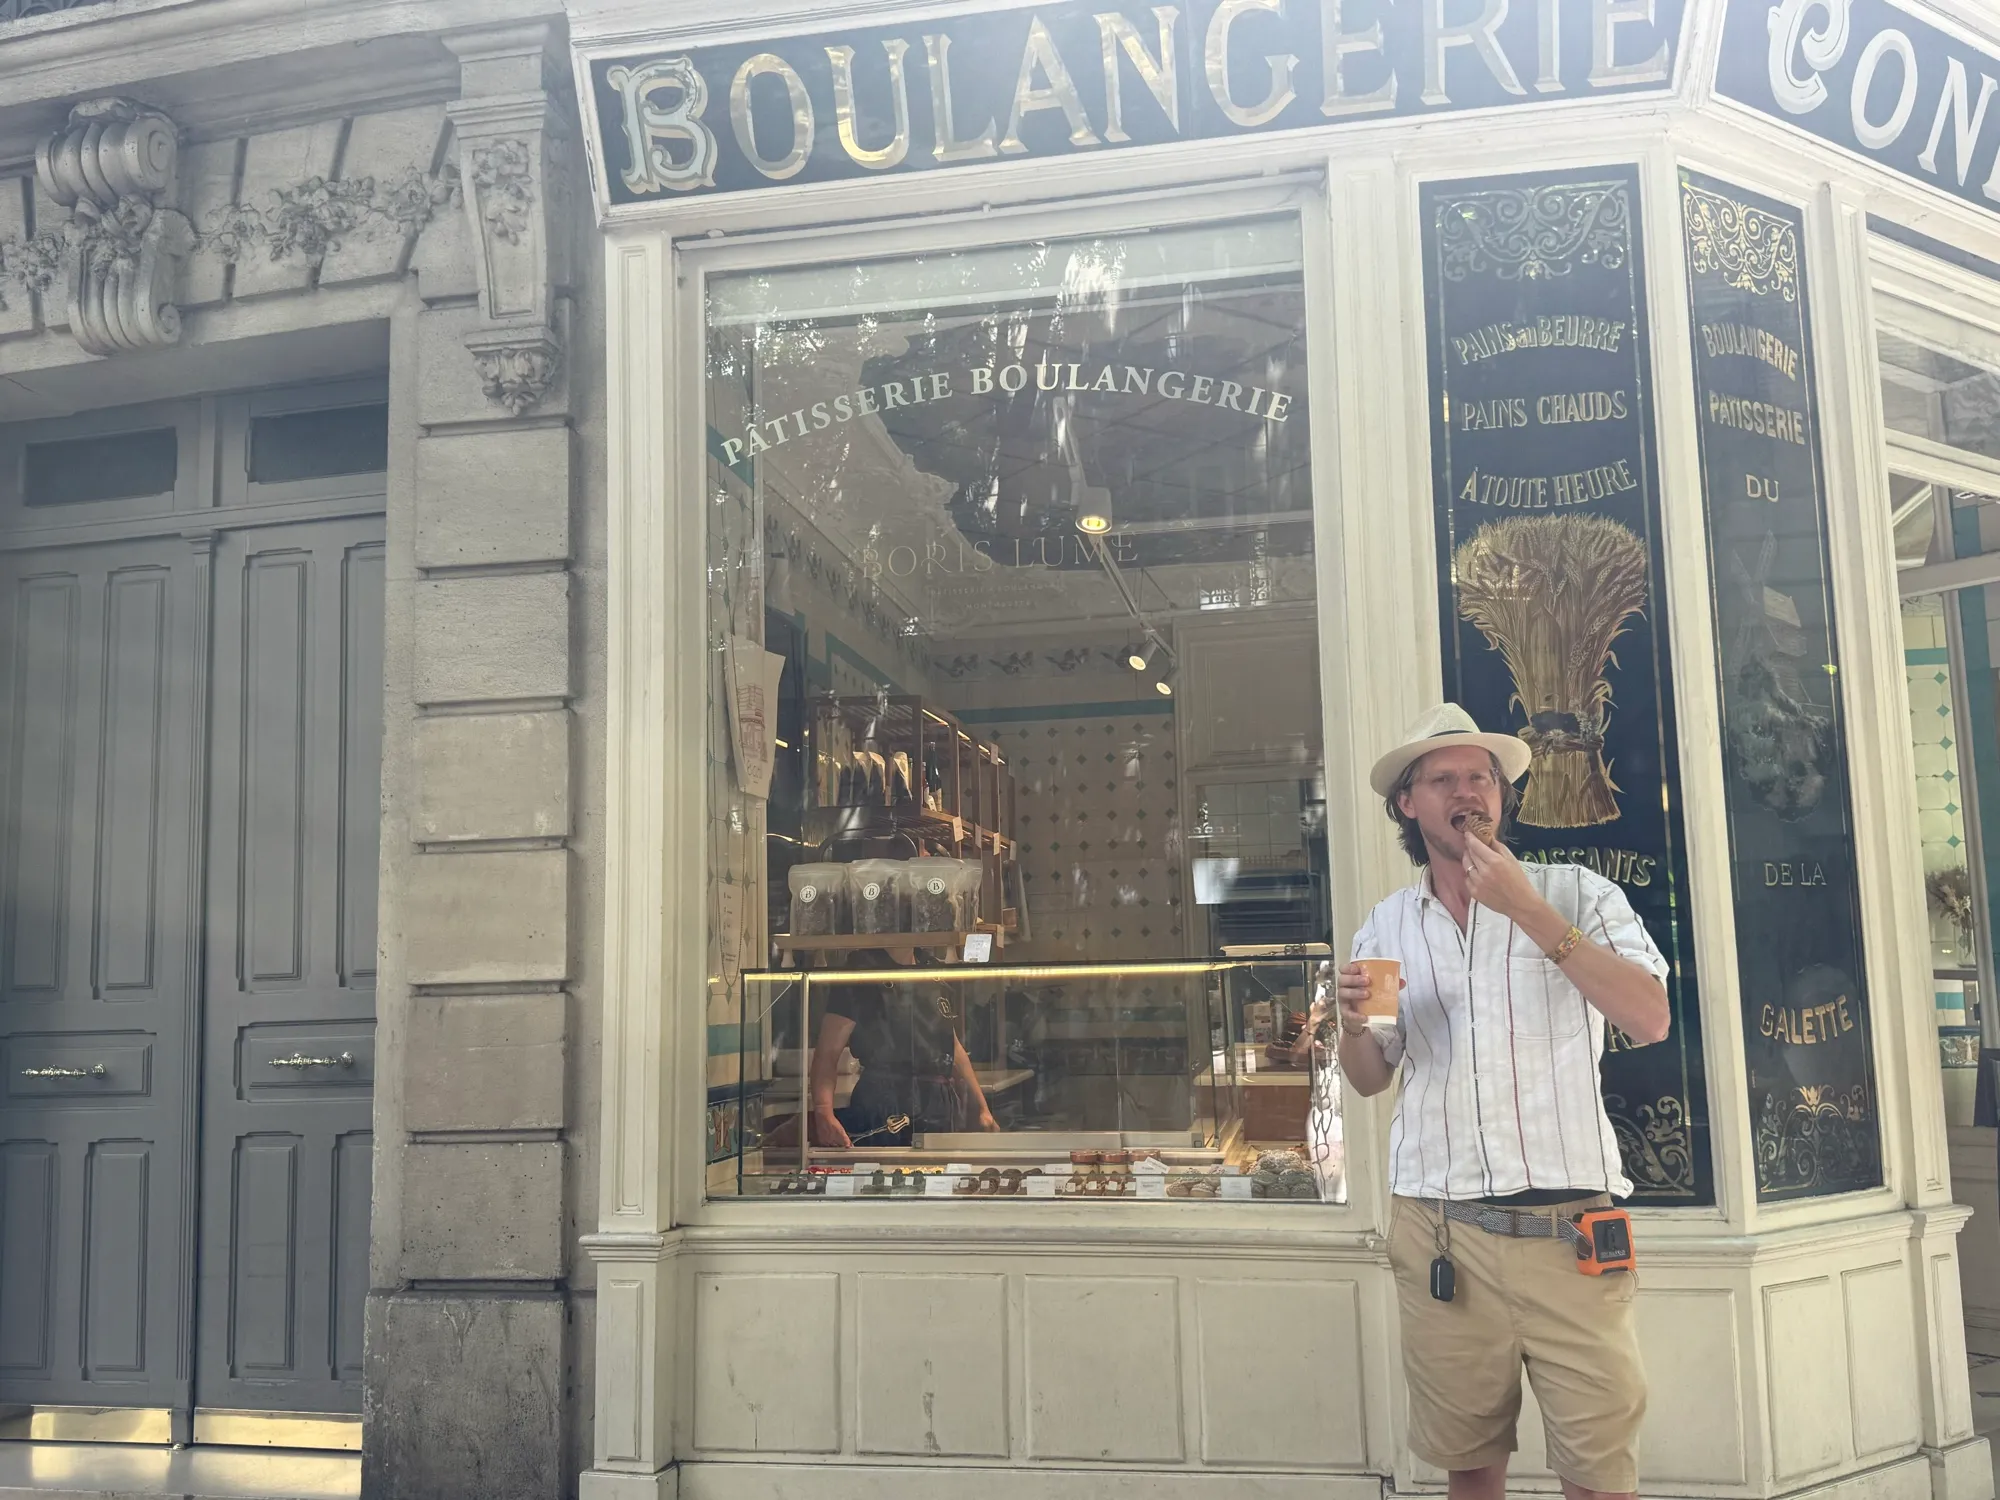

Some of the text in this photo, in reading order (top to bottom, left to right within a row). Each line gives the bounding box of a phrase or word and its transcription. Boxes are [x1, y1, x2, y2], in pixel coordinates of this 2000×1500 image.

[607, 0, 1669, 193] BOULANGERIE
[1767, 0, 2000, 203] CON
[1451, 321, 1517, 366] PAINS
[1537, 315, 1626, 353] BEURRE
[1701, 321, 1798, 382] BOULANGERIE
[721, 362, 1293, 468] PÂTISSERIE BOULANGERIE
[1461, 390, 1628, 431] PAINS CHAUDS
[1480, 474, 1548, 508] TOUTE
[1552, 458, 1638, 506] HEURE
[1744, 474, 1779, 502] DU
[862, 540, 993, 579] BORIS
[1764, 862, 1827, 887] DE LA
[1760, 994, 1854, 1045] GALETTE
